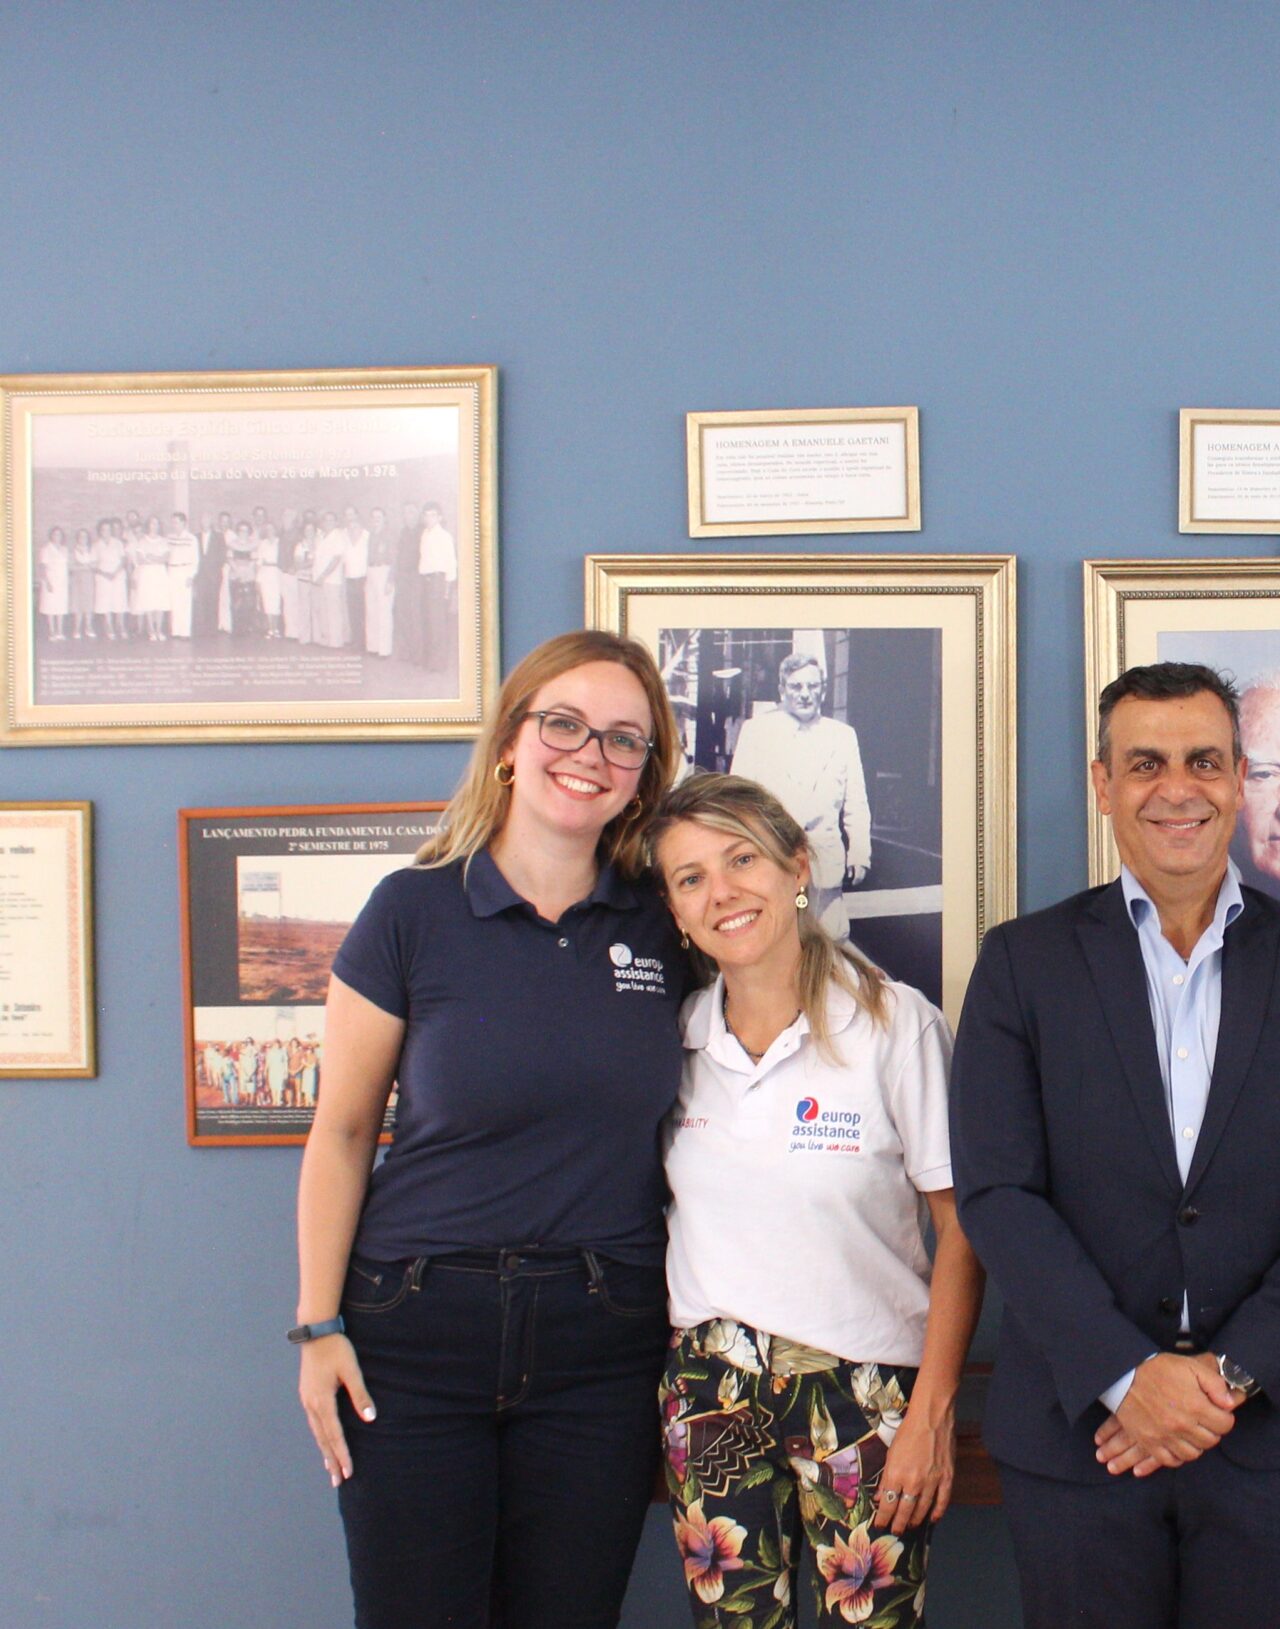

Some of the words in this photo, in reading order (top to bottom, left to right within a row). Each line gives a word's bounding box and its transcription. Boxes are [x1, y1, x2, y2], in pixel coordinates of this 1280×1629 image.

[716, 439, 780, 449] HOMENAGEM
[783, 440, 789, 448] A
[792, 438, 845, 448] EMANUELE
[848, 437, 890, 446] GAETANI
[1207, 443, 1271, 452] HOMENAGEM
[1273, 443, 1280, 452] A
[171, 468, 186, 481] da
[190, 466, 222, 481] Casa
[225, 466, 242, 480] do
[281, 465, 297, 480] 26
[300, 465, 315, 479] de
[319, 464, 360, 481] Março
[203, 826, 278, 839] LANÇAMENTO
[278, 827, 314, 838] PEDRA
[315, 826, 395, 838] FUNDAMENTAL
[396, 826, 425, 837] CASA
[298, 841, 351, 852] SEMESTRE
[353, 841, 366, 851] DE
[369, 841, 389, 851] 1975
[634, 957, 664, 972] europ
[822, 1111, 861, 1126] europ
[792, 1123, 861, 1139] assistance
[789, 1142, 806, 1152] you
[807, 1140, 824, 1151] live
[841, 1144, 860, 1153] care
